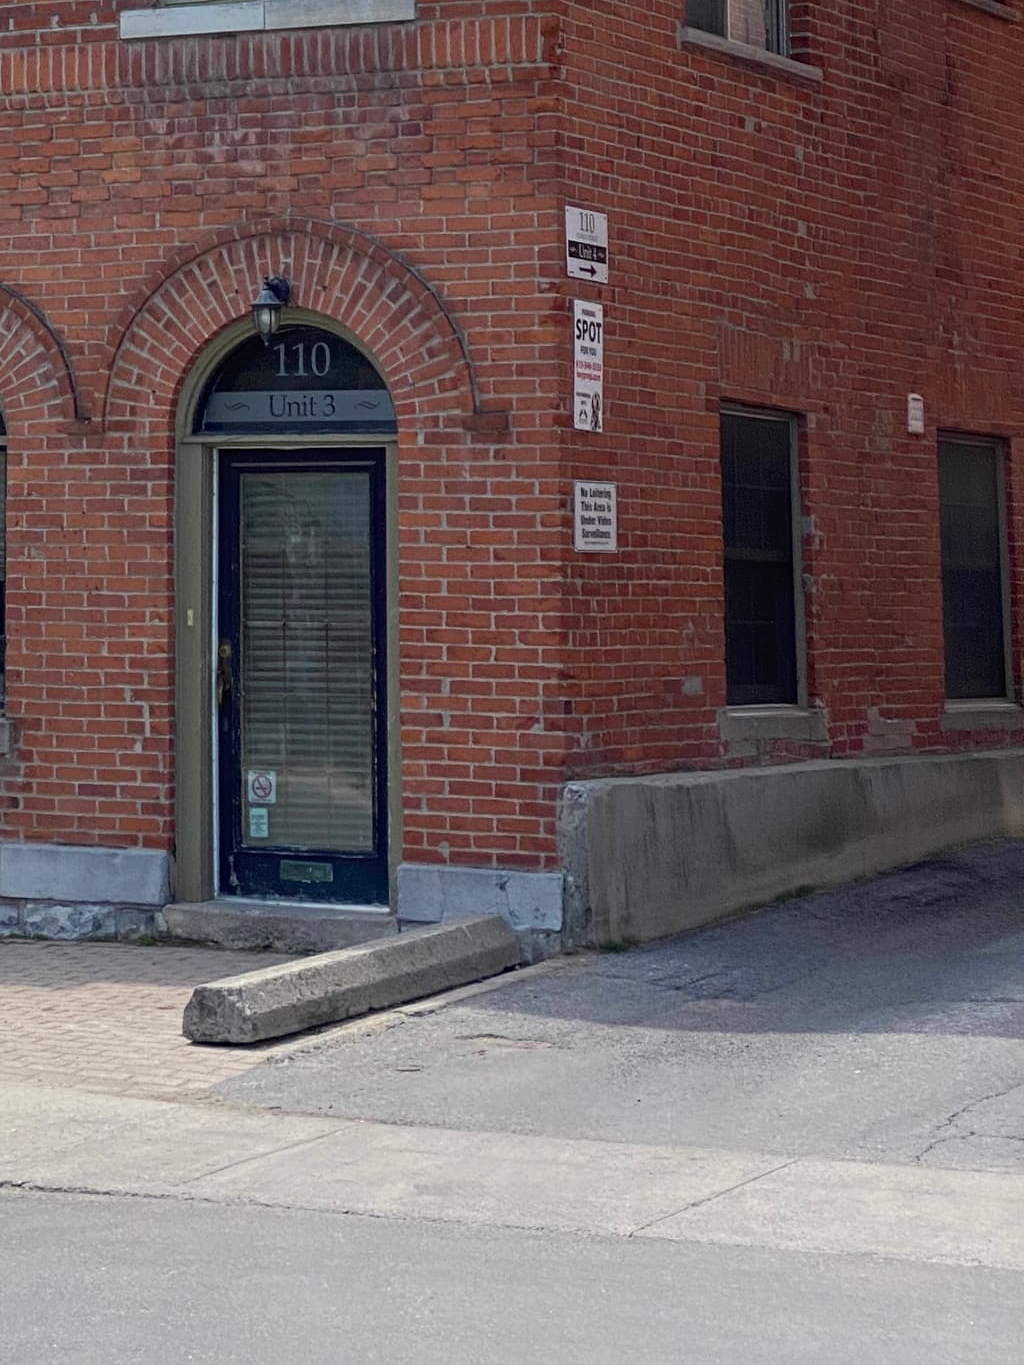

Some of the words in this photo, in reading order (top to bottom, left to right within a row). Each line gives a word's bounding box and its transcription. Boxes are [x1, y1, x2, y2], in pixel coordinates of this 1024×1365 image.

[579, 212, 595, 233] 110
[578, 243, 593, 259] Unit
[576, 318, 602, 344] SPOT
[580, 345, 588, 354] FOR
[589, 347, 597, 356] YOU
[273, 342, 331, 377] 110
[267, 394, 317, 417] Unit
[321, 395, 336, 417] 3
[581, 487, 588, 497] No
[589, 487, 611, 500] Loitering
[581, 501, 592, 511] This
[594, 502, 605, 512] Area
[581, 515, 596, 525] Under
